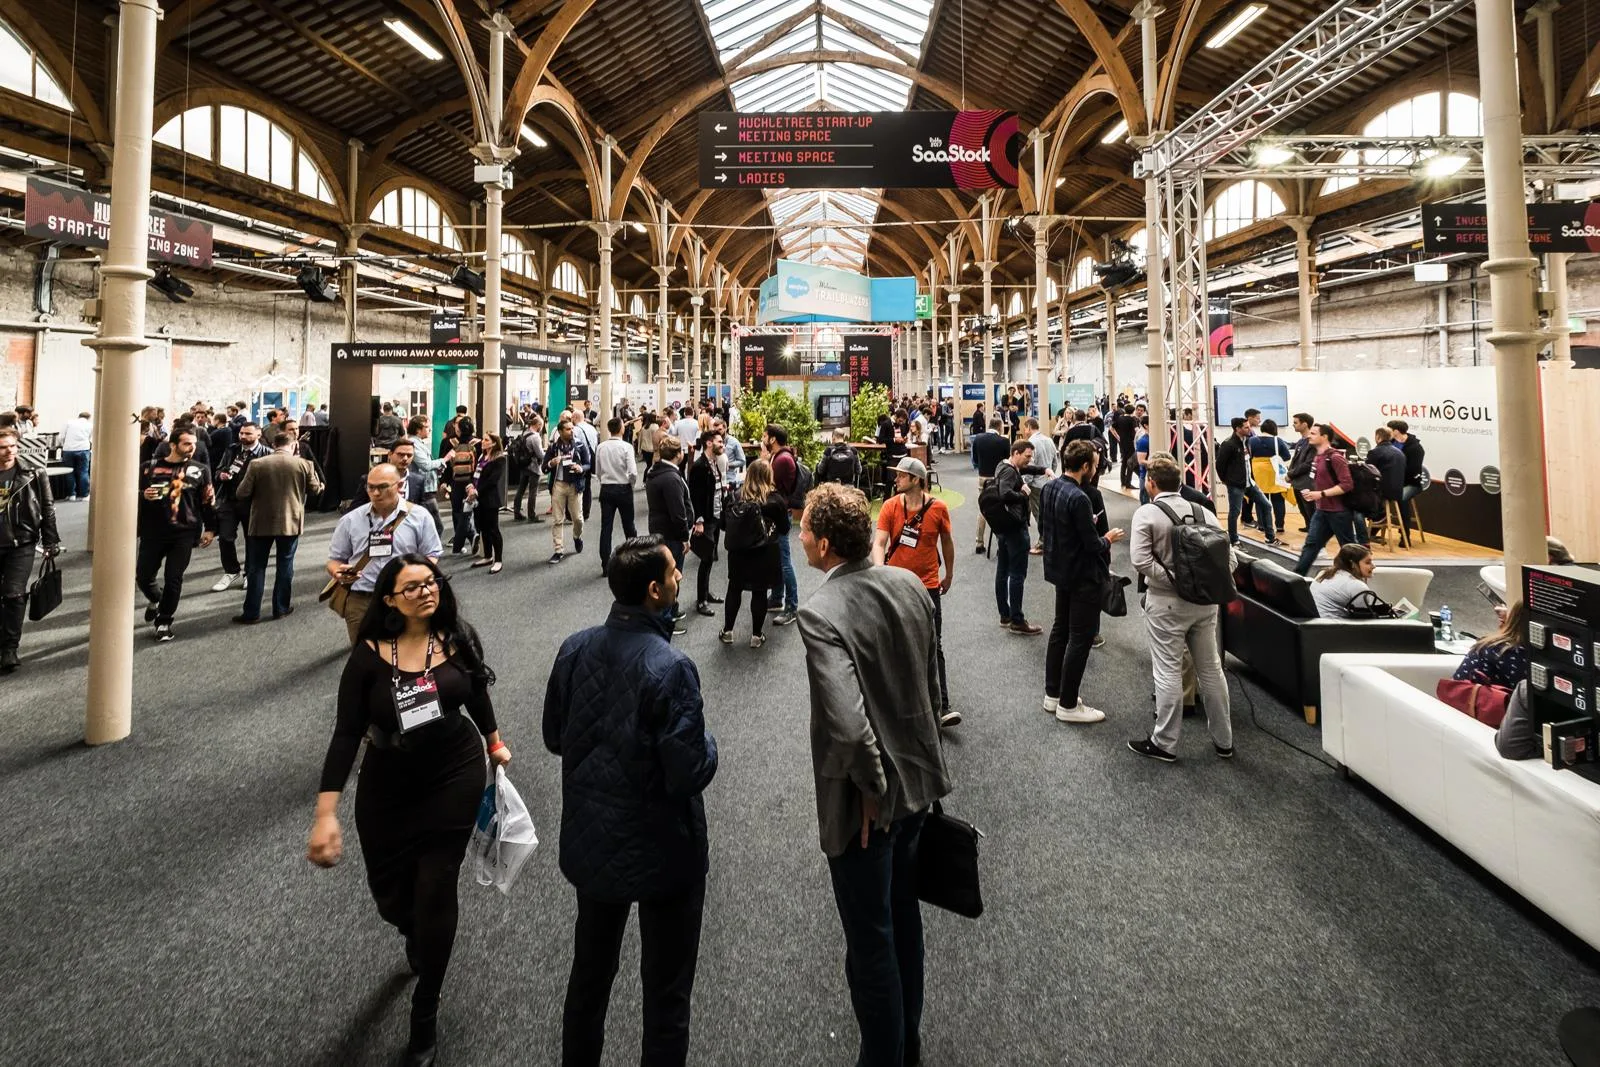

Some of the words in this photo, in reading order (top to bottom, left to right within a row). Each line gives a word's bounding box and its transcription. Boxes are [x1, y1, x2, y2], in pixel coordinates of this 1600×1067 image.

[817, 116, 873, 128] START-UP
[738, 130, 791, 142] MEETING
[794, 130, 832, 142] SPACE
[738, 151, 793, 163] MEETING
[796, 151, 835, 163] SPACE
[911, 144, 991, 163] SaaStock
[738, 172, 786, 184] LADIES
[47, 214, 111, 241] START-U
[352, 349, 377, 357] WE'RE
[379, 349, 408, 357] GIVING
[409, 349, 436, 357] AWAY
[1422, 424, 1460, 436] subscription
[1461, 425, 1493, 436] business
